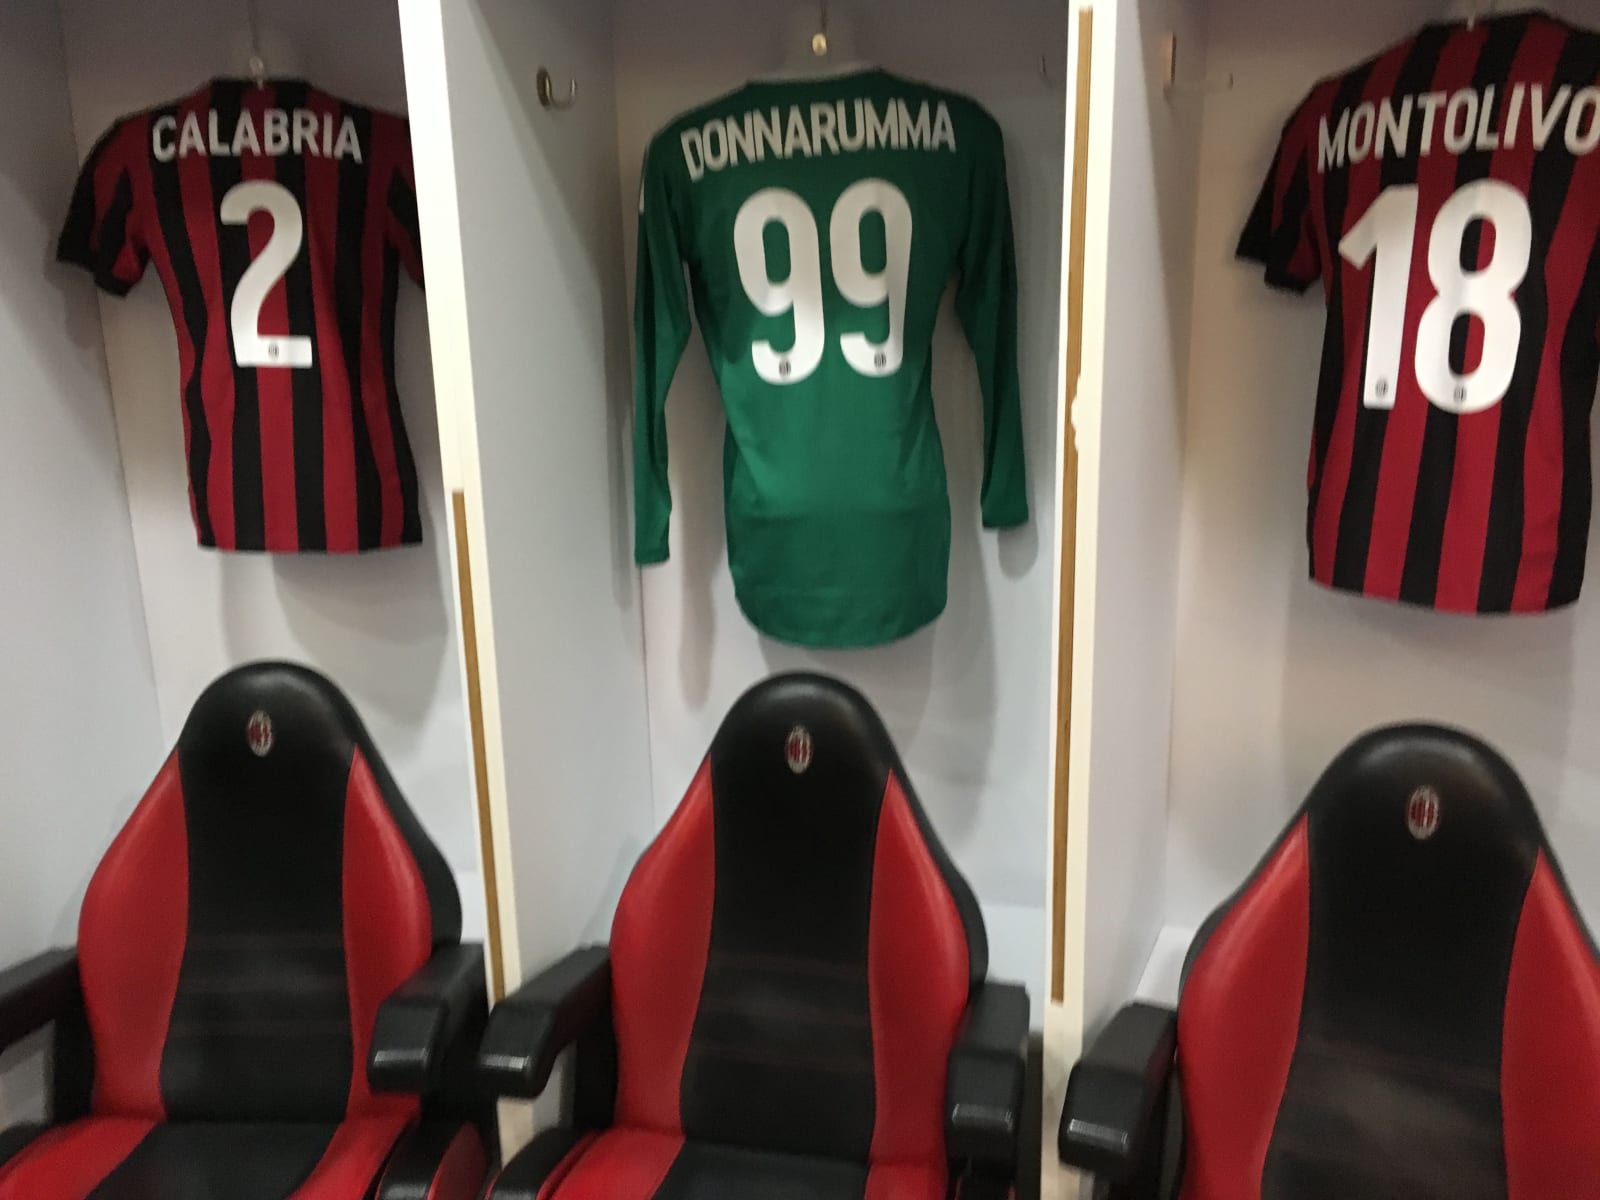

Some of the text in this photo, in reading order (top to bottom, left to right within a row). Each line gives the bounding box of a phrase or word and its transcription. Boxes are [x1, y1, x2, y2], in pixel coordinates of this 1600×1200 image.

[151, 109, 363, 163] CALABRIA
[680, 98, 957, 182] DONNARUMMA
[1317, 83, 1600, 172] MONTOLIVO
[219, 180, 313, 369] 2
[733, 178, 913, 386] 99
[1337, 179, 1533, 414] 18
